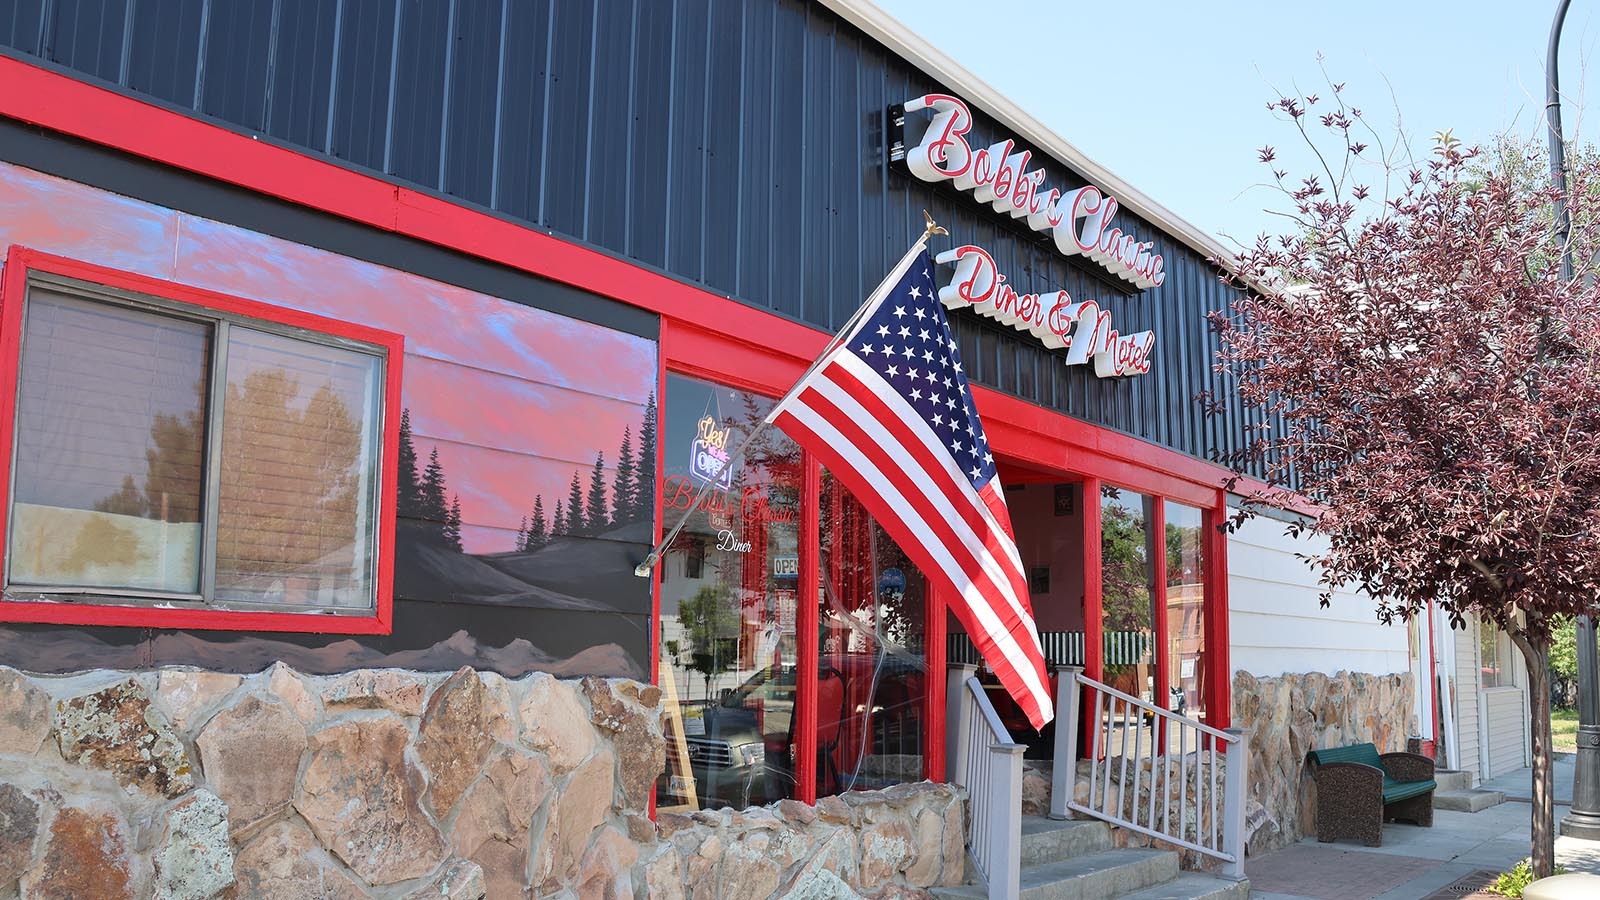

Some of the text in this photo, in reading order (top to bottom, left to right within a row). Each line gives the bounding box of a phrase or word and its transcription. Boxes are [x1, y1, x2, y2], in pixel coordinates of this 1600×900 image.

[918, 93, 1166, 289] Bobbi's Classic
[950, 244, 1156, 377] Diner & Motel
[700, 416, 732, 450] Yes!
[742, 487, 796, 524] Classic
[716, 529, 753, 553] Diner
